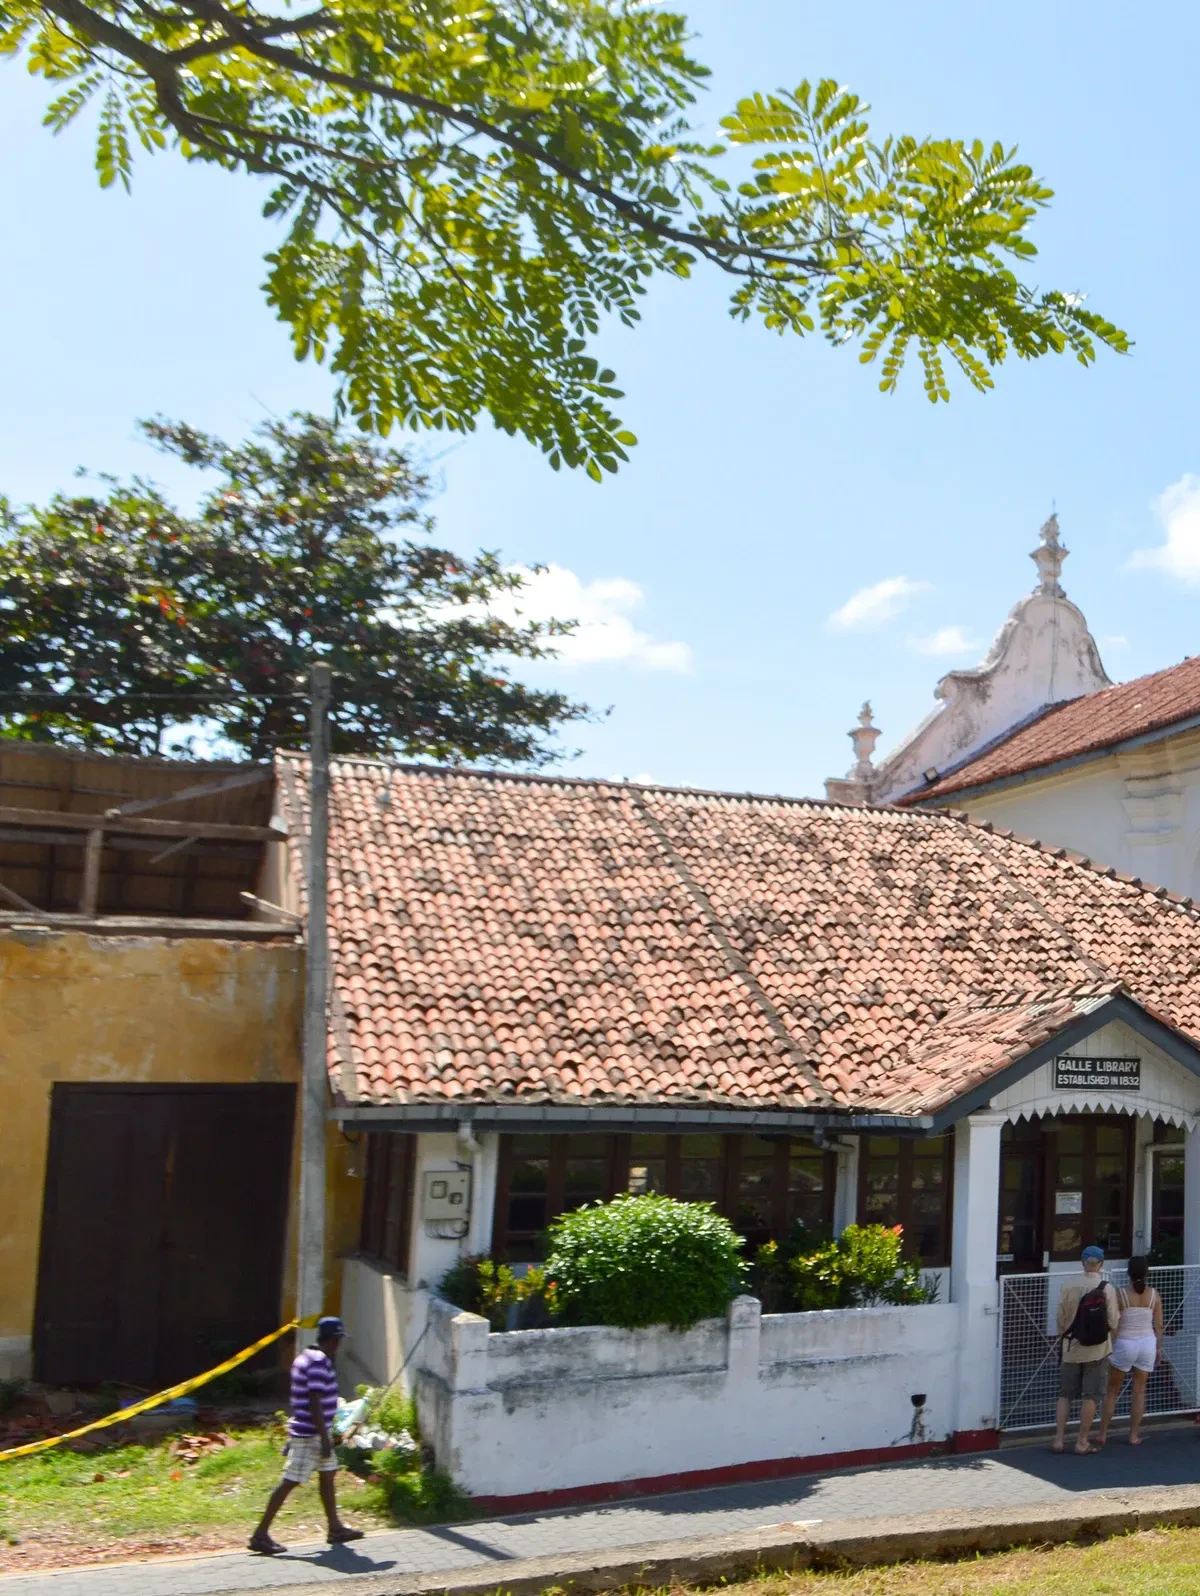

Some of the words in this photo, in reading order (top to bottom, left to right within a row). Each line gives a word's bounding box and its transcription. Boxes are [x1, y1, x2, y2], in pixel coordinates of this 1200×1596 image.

[1058, 1060, 1092, 1071] GALLE
[1096, 1061, 1138, 1072] LIBRARY
[1058, 1075, 1109, 1085] ESTABLISHED
[1111, 1076, 1118, 1085] IN
[1119, 1077, 1139, 1085] 1832
